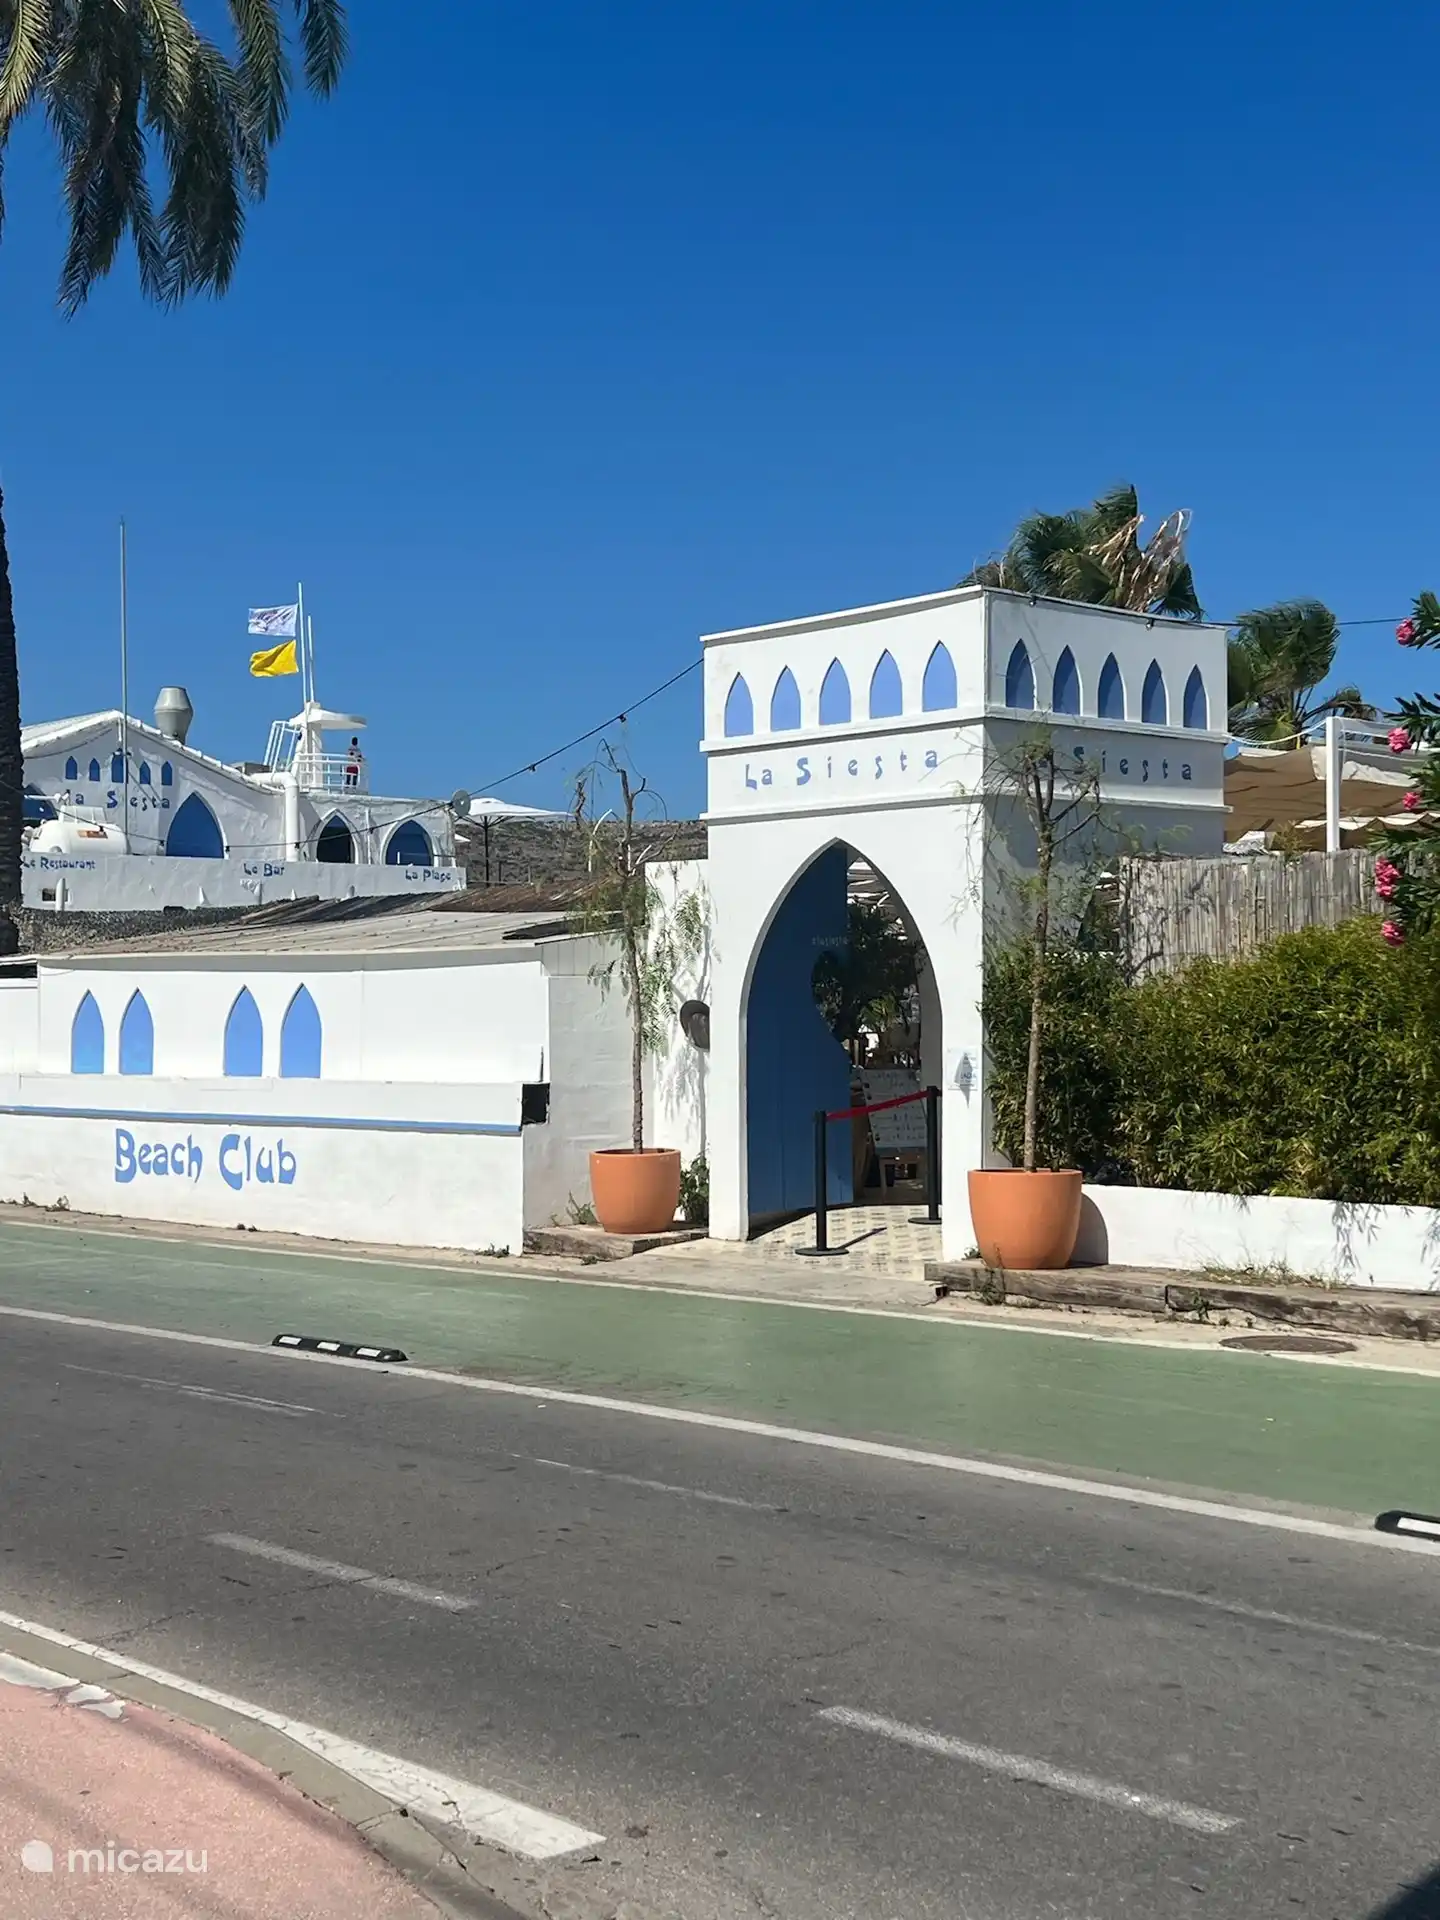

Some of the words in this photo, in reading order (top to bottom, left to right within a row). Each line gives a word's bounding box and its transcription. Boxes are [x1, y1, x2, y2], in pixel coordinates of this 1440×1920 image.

[745, 763, 773, 790] La
[796, 750, 938, 786] Siesta
[263, 863, 285, 876] Bar
[405, 869, 418, 881] La
[423, 868, 451, 883] Plage
[115, 1128, 203, 1183] Beach
[219, 1133, 296, 1190] Club
